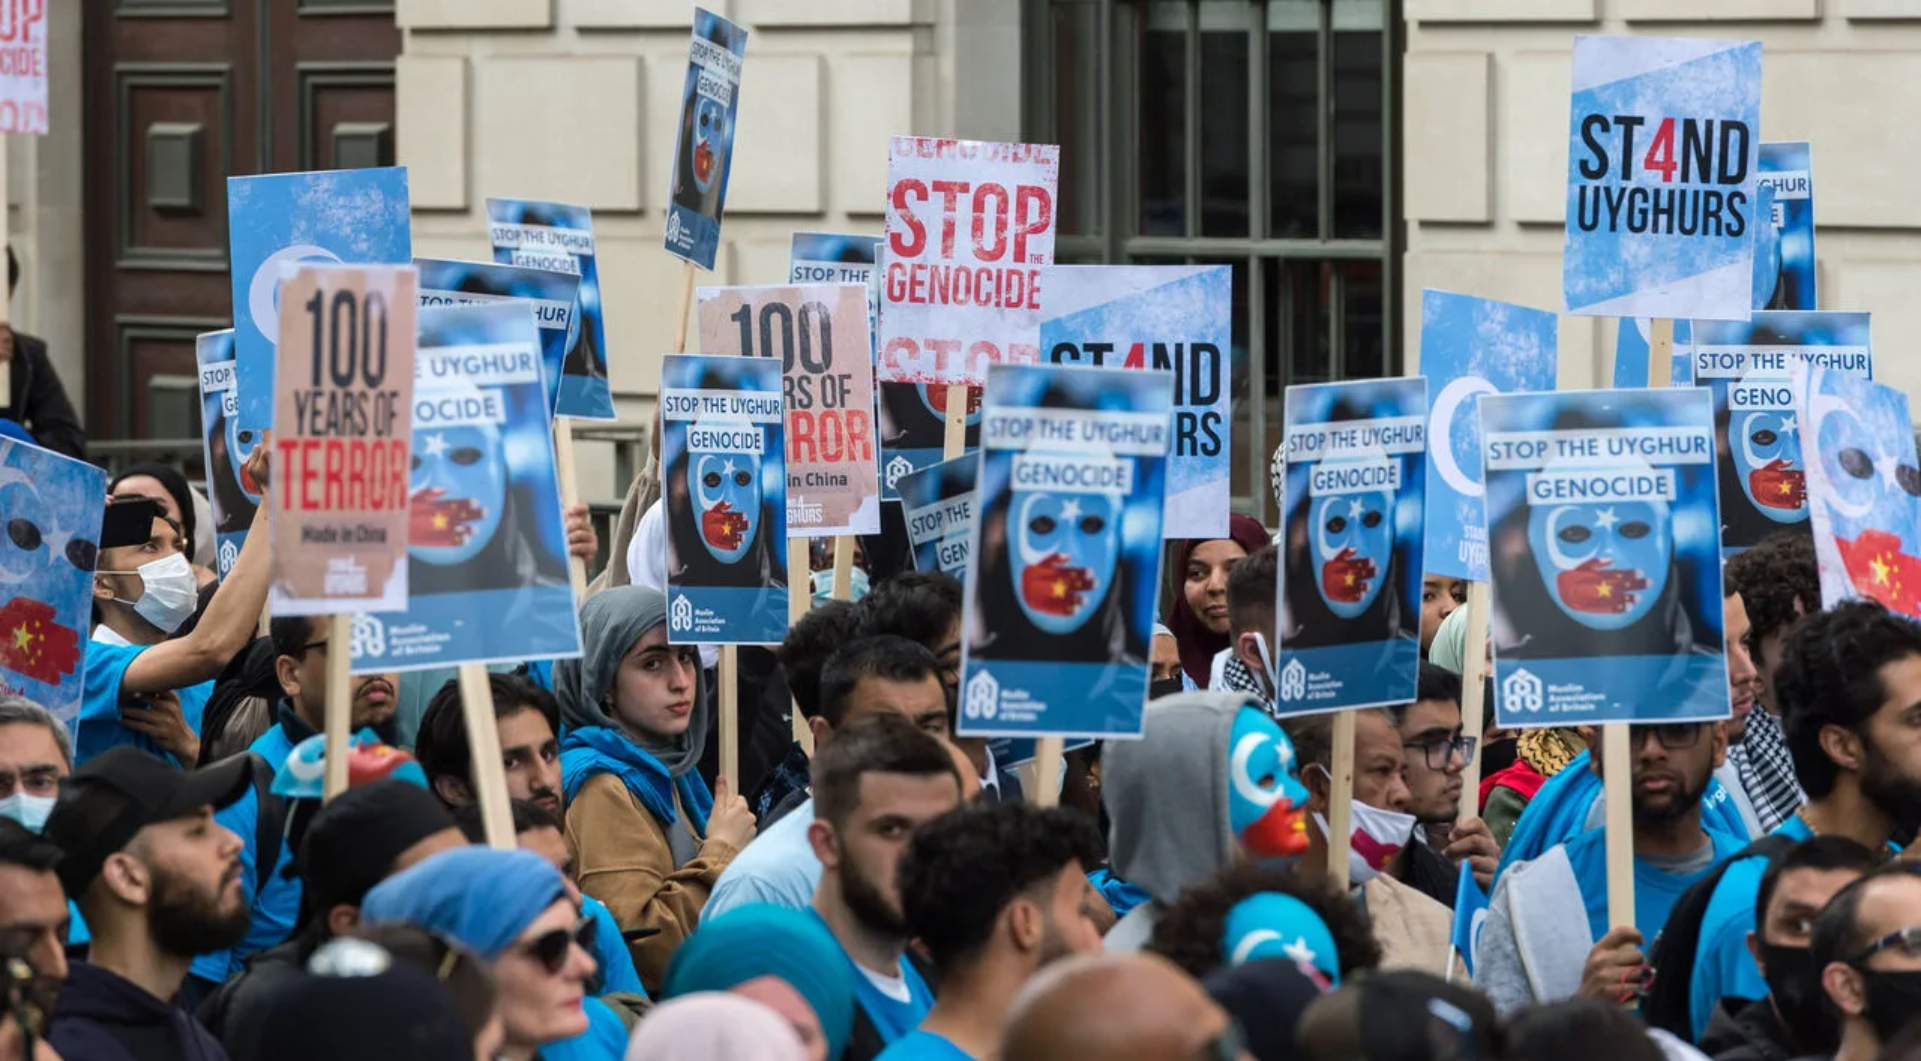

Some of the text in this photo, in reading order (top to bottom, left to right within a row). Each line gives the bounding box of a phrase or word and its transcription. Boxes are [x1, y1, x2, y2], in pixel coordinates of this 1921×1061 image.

[1579, 114, 1749, 185] ST4ND
[889, 178, 1052, 264] STOP THE
[1578, 185, 1747, 237] UYGHURS
[493, 228, 521, 241] STOP
[524, 230, 545, 243] THE
[515, 255, 578, 273] GENOCIDE
[794, 266, 835, 281] STOP
[887, 262, 1041, 310] GENOCIDE
[306, 289, 387, 389] 100
[731, 301, 834, 375] 100
[430, 351, 535, 378] UYGHUR
[1699, 353, 1745, 370] STOP
[1751, 353, 1786, 370] THE
[203, 368, 231, 385] STOP
[820, 374, 852, 408] OF
[294, 389, 400, 438] YEARS OF
[666, 396, 781, 417] STOP THE UYGHUR
[690, 431, 761, 450] GENOCIDE
[989, 417, 1165, 445] STOP THE UYGHUR
[1290, 424, 1424, 453] STOP THE UYGHUR
[1489, 435, 1707, 461] STOP THE UYGHUR
[276, 439, 408, 512] TERROR
[806, 472, 849, 487] China
[1015, 463, 1128, 488] GENOCIDE
[1313, 465, 1398, 491] GENOCIDE
[1533, 475, 1669, 499] GENOCIDE
[911, 501, 971, 536] STOP THE
